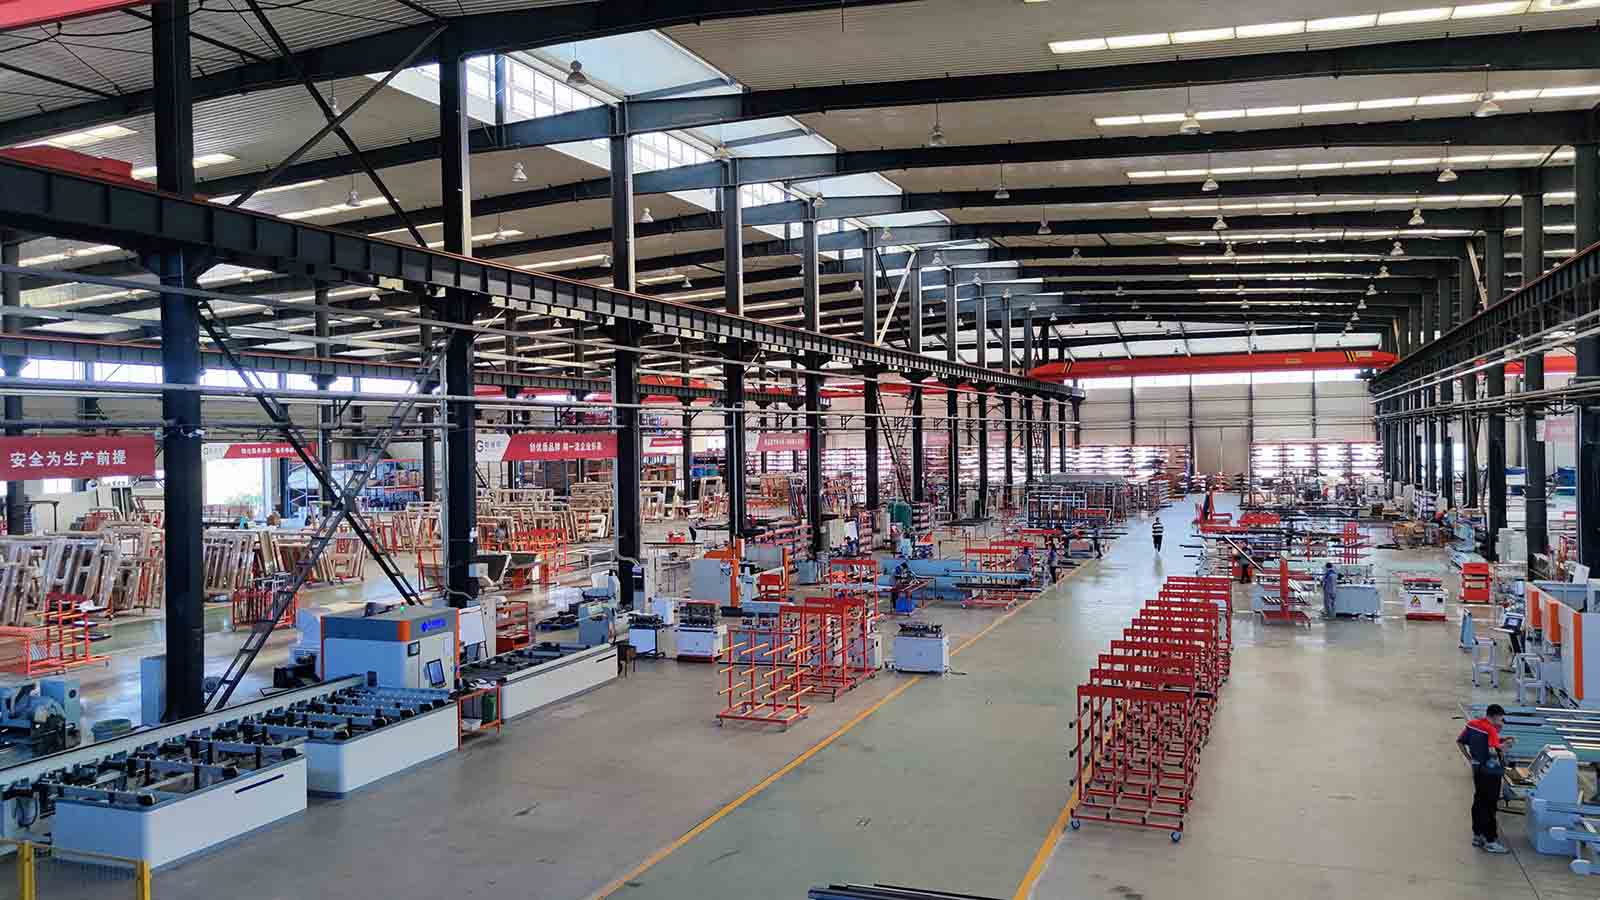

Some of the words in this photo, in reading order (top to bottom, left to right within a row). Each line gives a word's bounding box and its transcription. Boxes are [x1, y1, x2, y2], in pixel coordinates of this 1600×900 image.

[9, 449, 127, 468] 安全为生产前提
